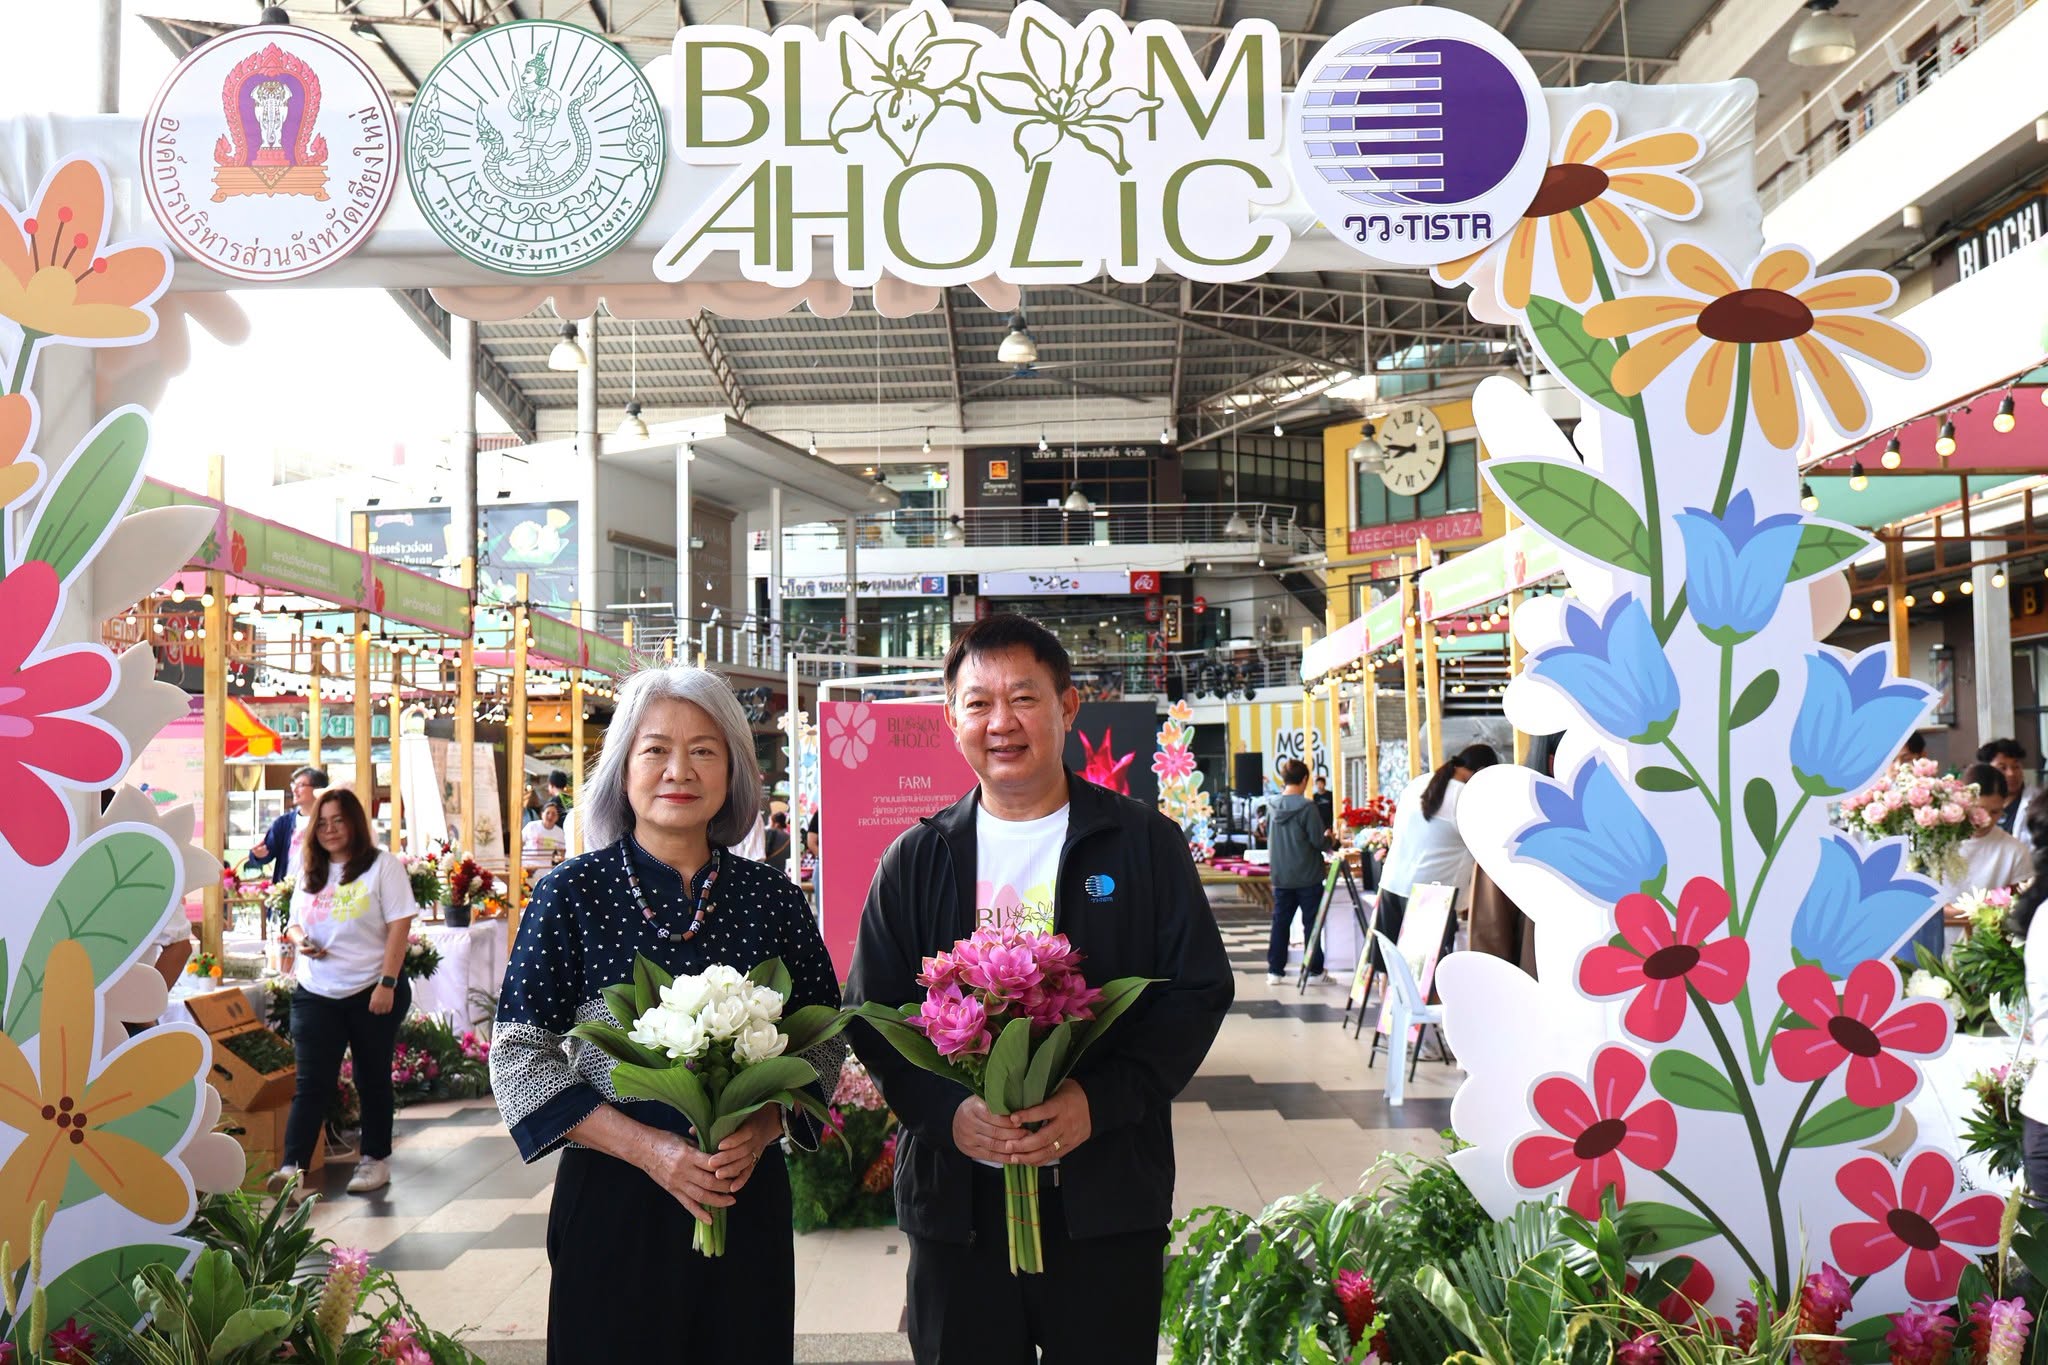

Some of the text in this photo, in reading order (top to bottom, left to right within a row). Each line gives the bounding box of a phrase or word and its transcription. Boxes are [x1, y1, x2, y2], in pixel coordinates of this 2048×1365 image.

[156, 105, 385, 268] องค์การบริหารส่วนจังหวัดเชียงใหม่
[434, 196, 634, 261] กรมส่งเสริมการเกษตร
[666, 157, 1275, 272] AHOLIC
[1436, 517, 1482, 539] PLAZA
[1275, 749, 1329, 777] CK
[898, 775, 932, 790] FARM
[858, 817, 880, 827] FROM
